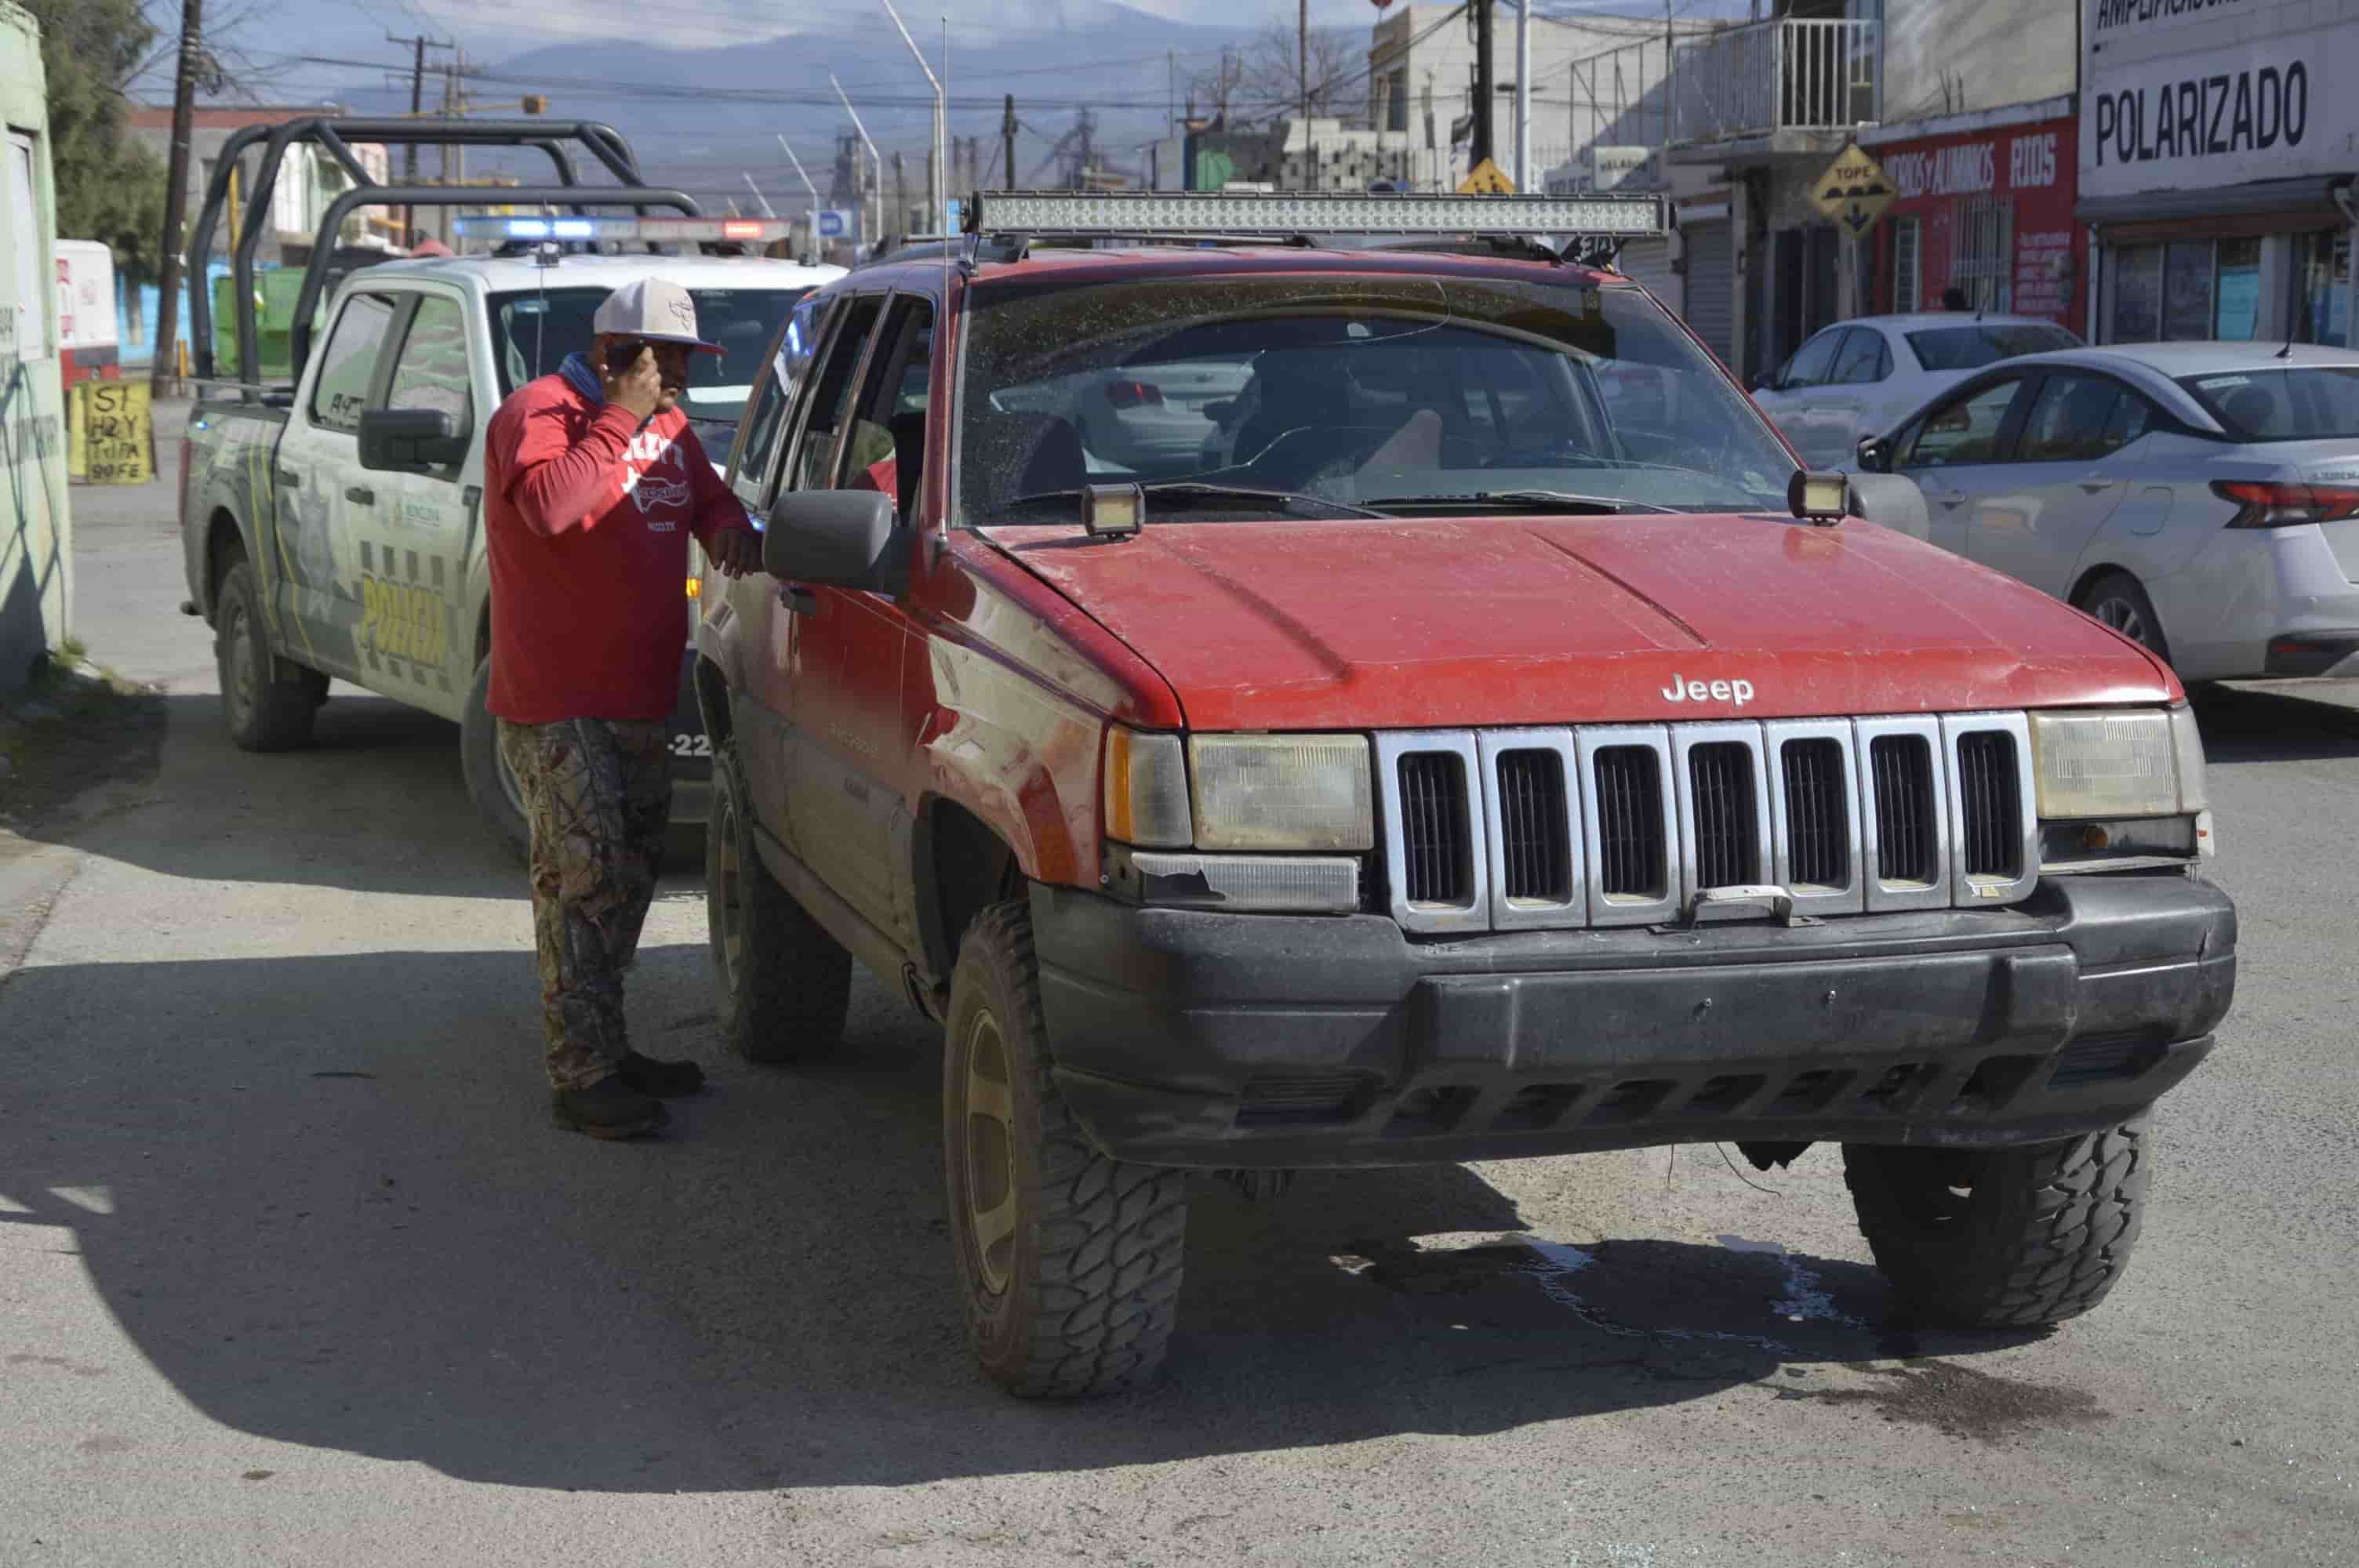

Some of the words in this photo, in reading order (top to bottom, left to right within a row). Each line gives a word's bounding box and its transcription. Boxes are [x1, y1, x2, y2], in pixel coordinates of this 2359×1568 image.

[2095, 60, 2308, 167] POLARIZADO
[1836, 165, 1871, 180] TOPE
[2009, 132, 2058, 189] RIOS
[1660, 673, 1754, 707] Jeep
